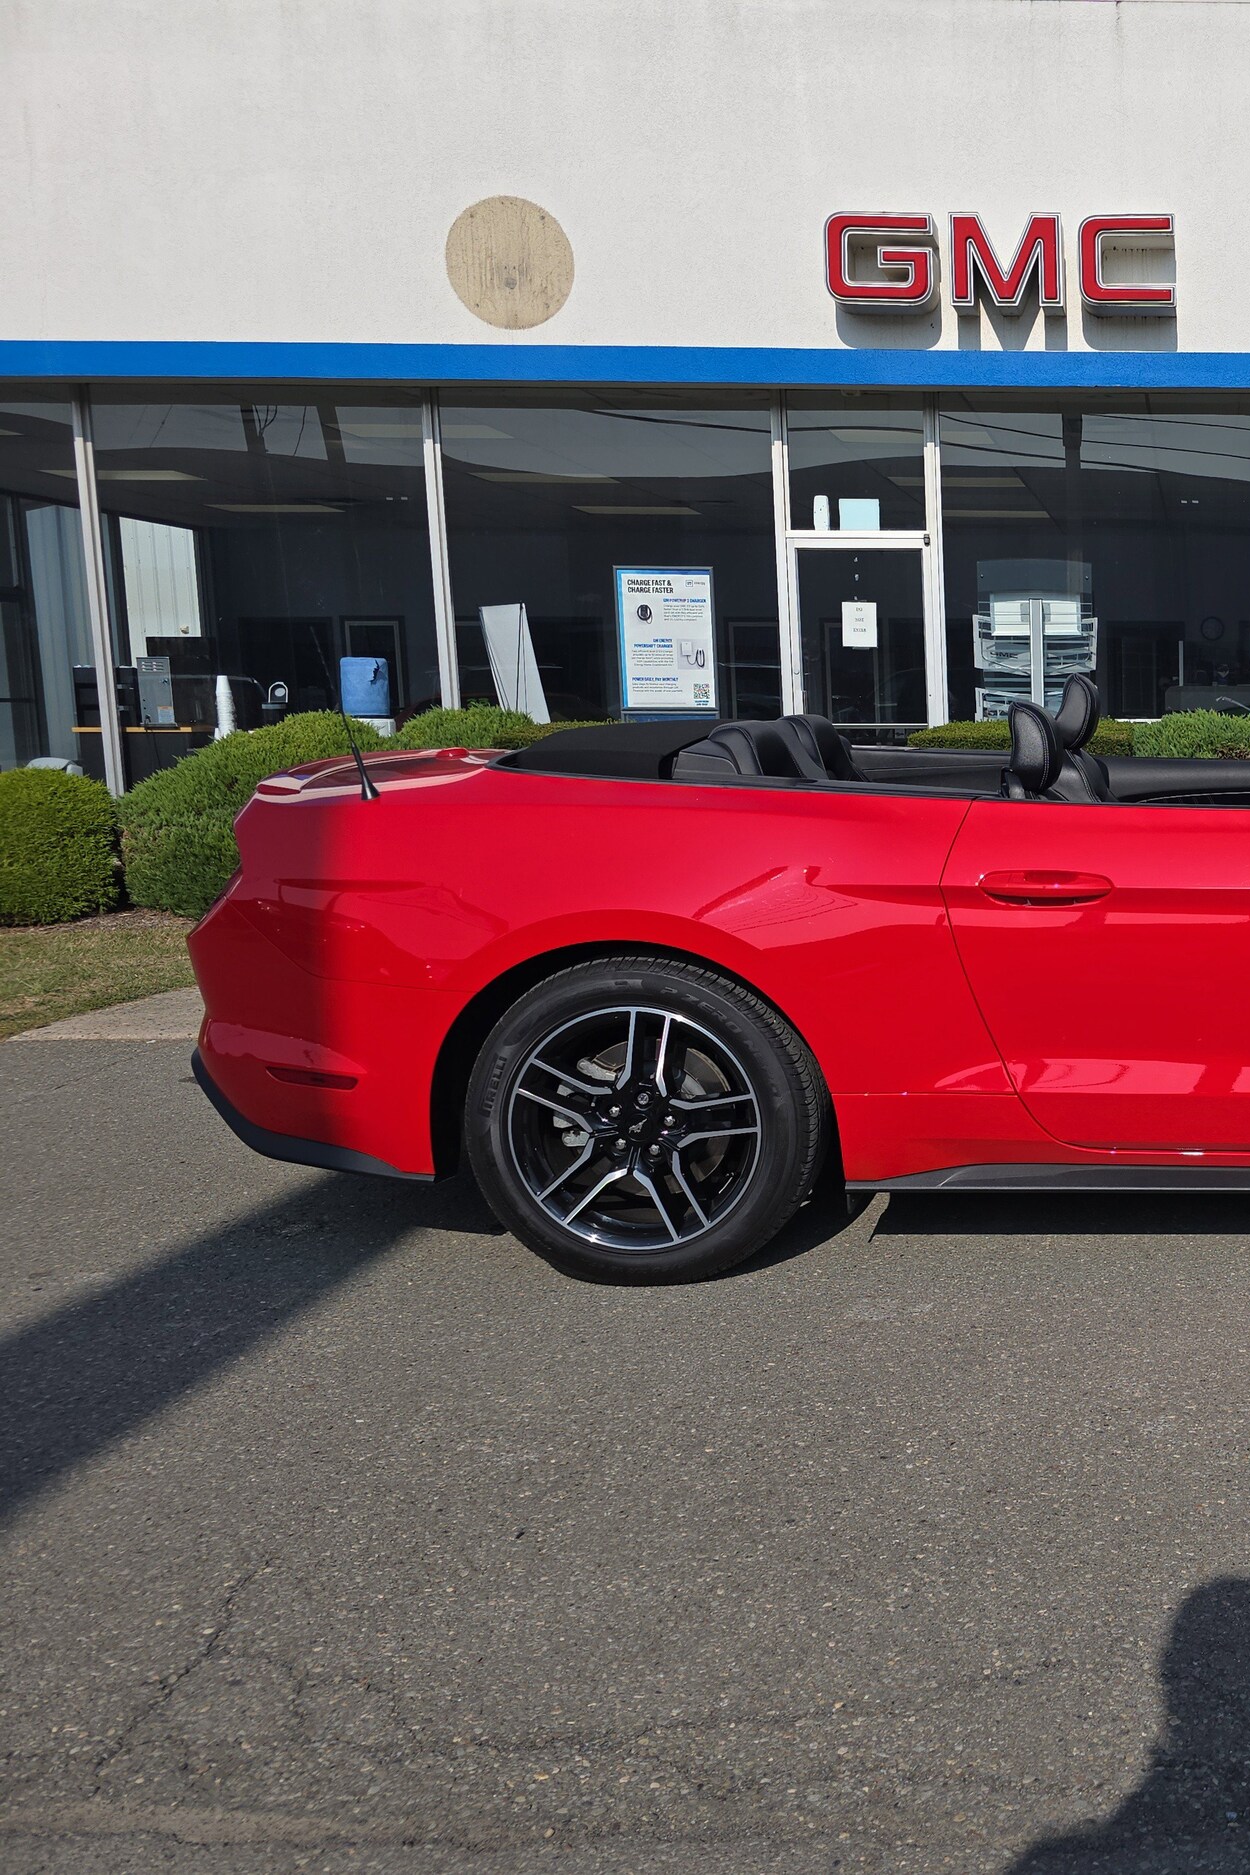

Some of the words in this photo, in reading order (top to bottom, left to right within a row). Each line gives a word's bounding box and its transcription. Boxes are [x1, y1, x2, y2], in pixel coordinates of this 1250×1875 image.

[824, 211, 1177, 311] GMC
[627, 586, 651, 594] CHARGE
[651, 586, 674, 594] FASTER
[651, 579, 666, 587] FAST
[480, 1053, 508, 1117] PIRELLI
